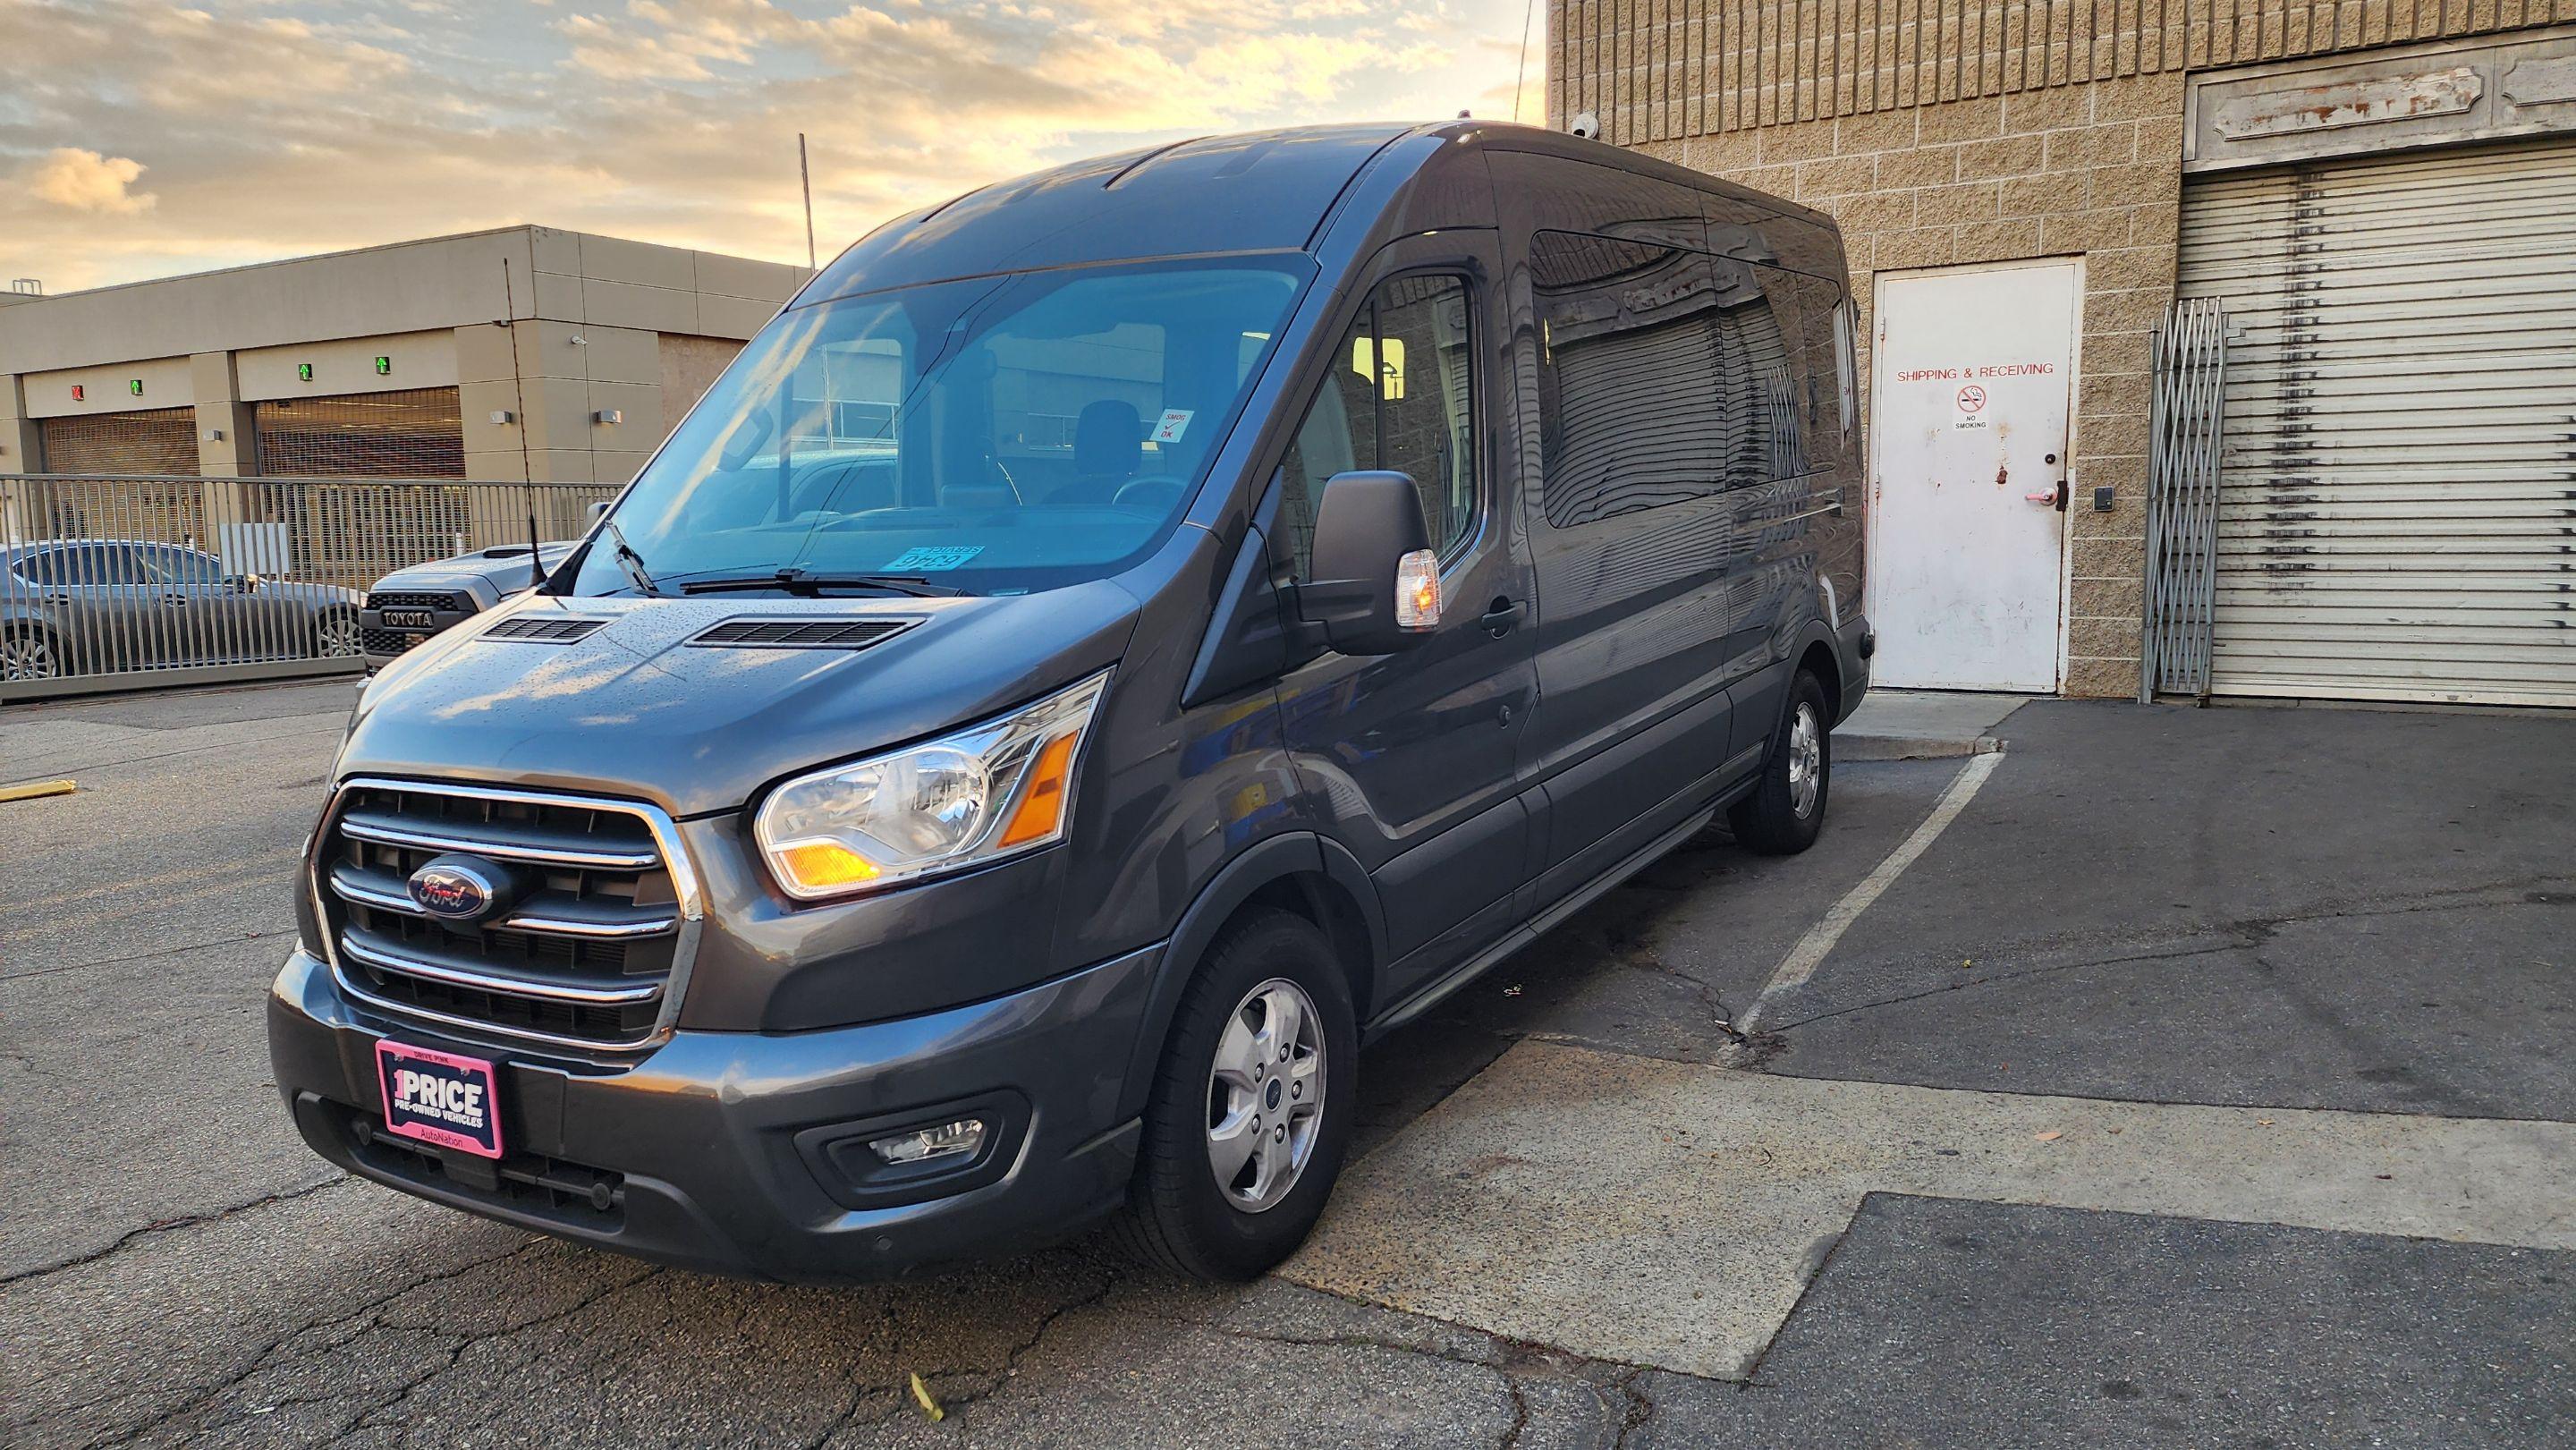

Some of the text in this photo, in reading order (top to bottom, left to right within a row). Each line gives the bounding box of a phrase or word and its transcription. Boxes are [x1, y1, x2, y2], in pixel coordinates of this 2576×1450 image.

[1897, 362, 2054, 382] SHIPPING & RECEIVING
[1165, 413, 1186, 421] SMOG
[1955, 421, 1987, 429] SMOKING
[1160, 430, 1174, 438] OK
[383, 612, 433, 626] TOYOTA
[419, 874, 467, 908] Ford
[413, 1050, 432, 1062] DRIVE
[394, 1098, 483, 1129] PRE-OWNED VEHICLES
[420, 1128, 463, 1149] AutoNation
